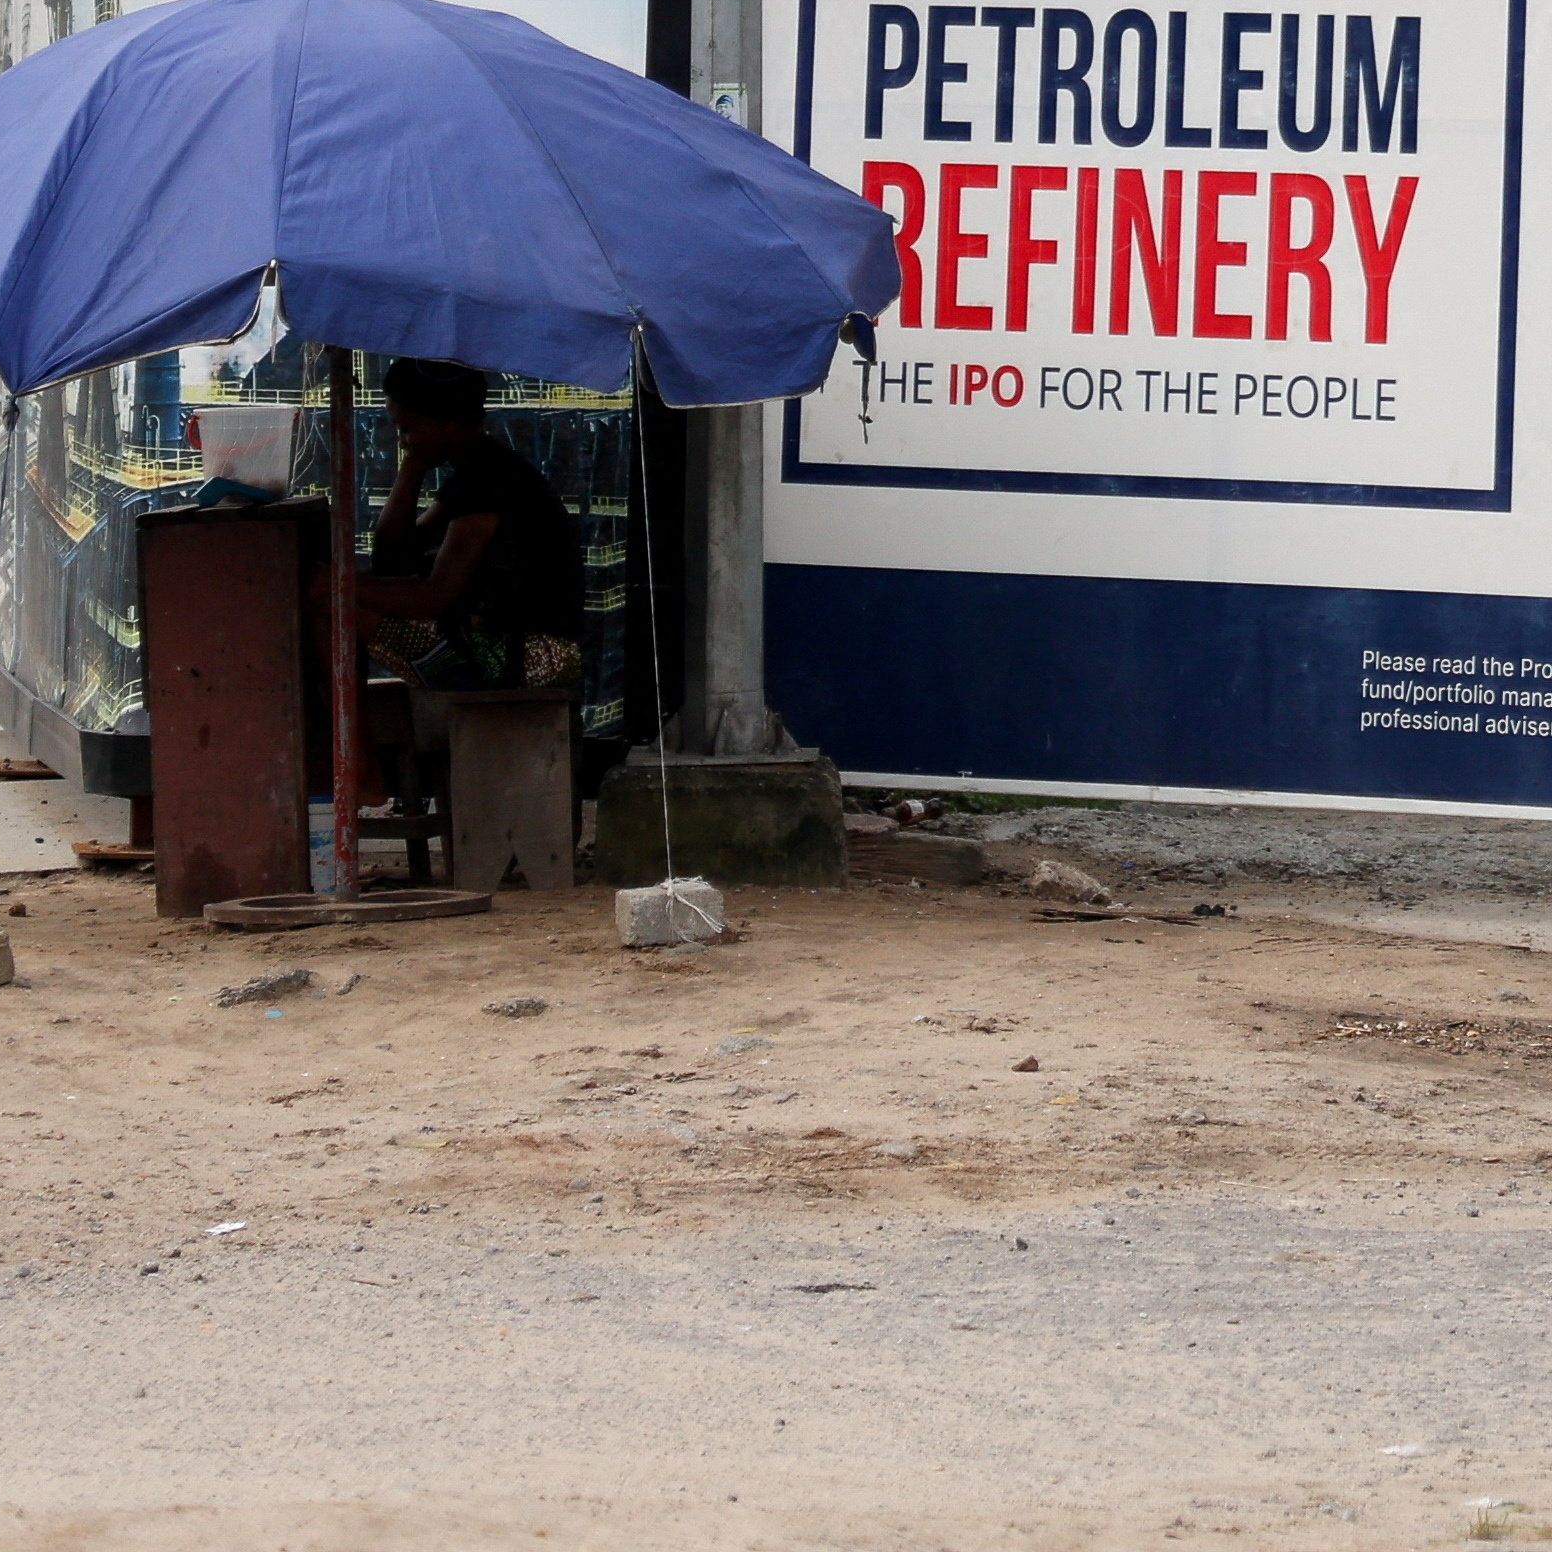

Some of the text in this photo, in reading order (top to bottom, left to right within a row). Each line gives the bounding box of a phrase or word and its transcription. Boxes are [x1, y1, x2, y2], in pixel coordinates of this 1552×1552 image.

[864, 3, 1422, 154] PETROLEUM
[863, 161, 1419, 344] REFINERY
[852, 359, 1397, 422] THE IPO FOR THE PEOPLE
[1362, 650, 1426, 673] Please
[1432, 656, 1476, 675] read
[1482, 657, 1515, 677] the
[1360, 677, 1496, 706] fund/portfolio
[1360, 707, 1480, 732] professional
